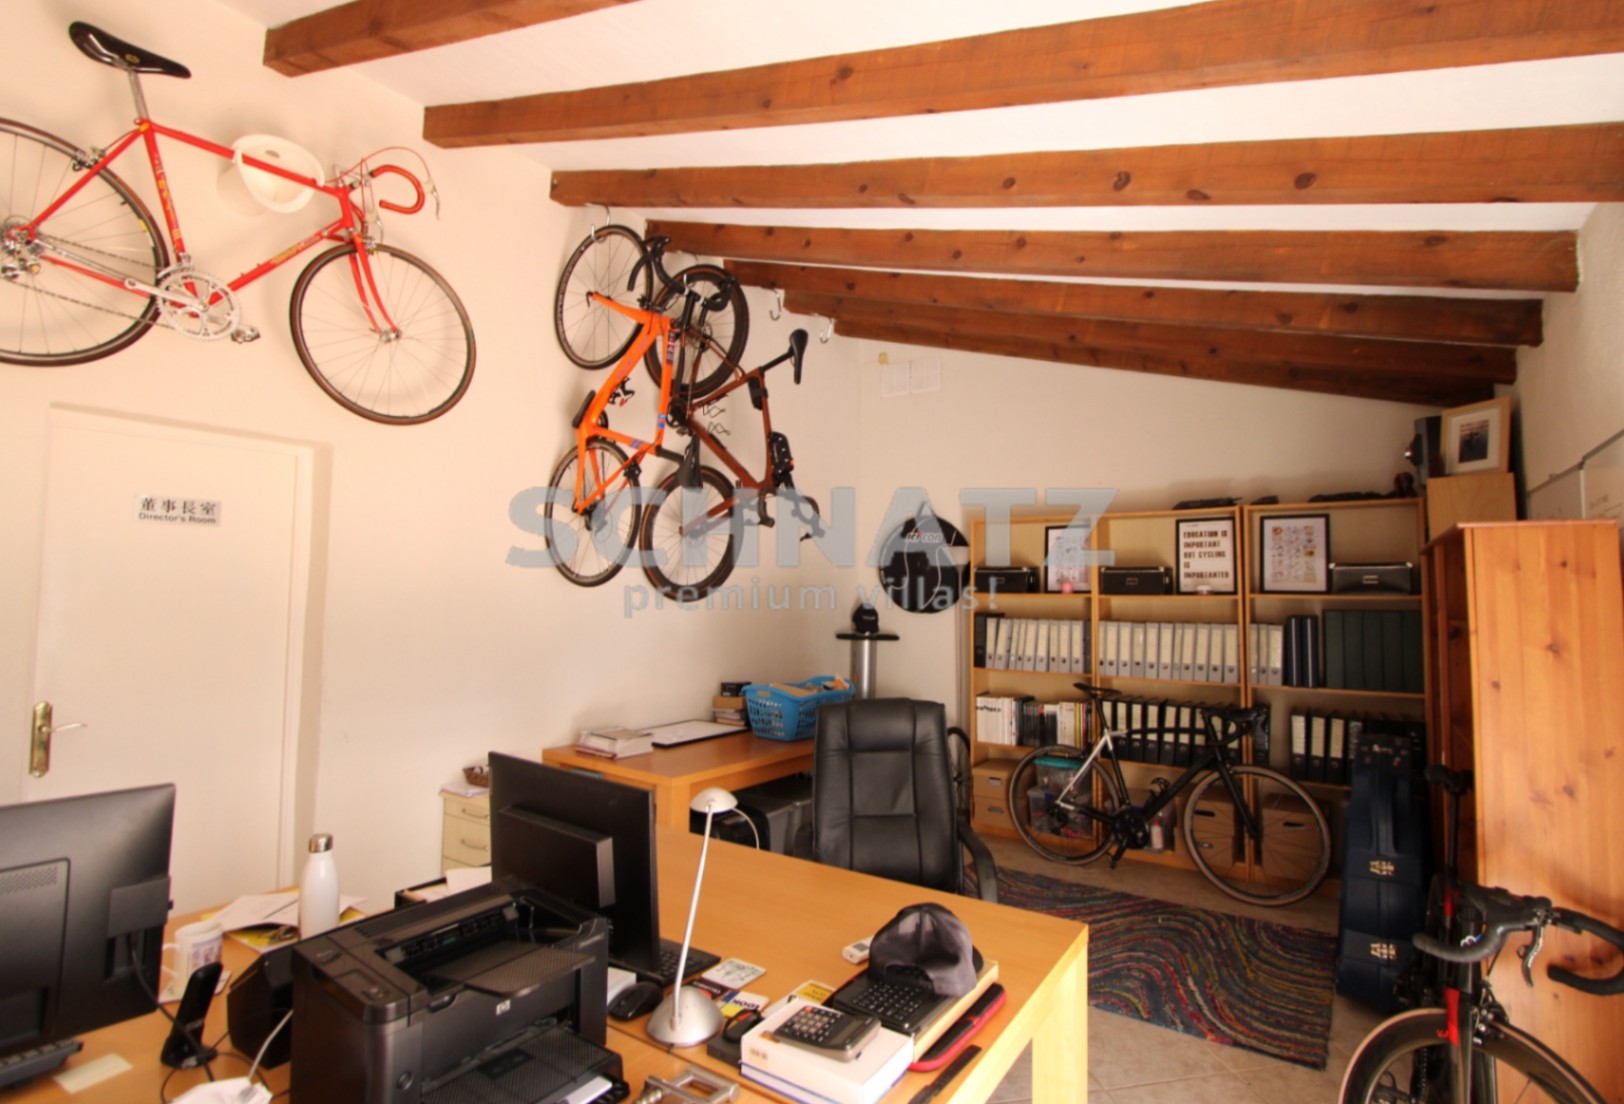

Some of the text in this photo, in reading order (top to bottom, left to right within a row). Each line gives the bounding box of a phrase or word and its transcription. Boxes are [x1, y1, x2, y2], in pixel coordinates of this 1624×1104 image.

[138, 513, 216, 524] Director's Room
[1183, 530, 1219, 539] EDUCATION
[1183, 541, 1220, 549] IMPORTANT
[1198, 550, 1226, 558] CYCLING
